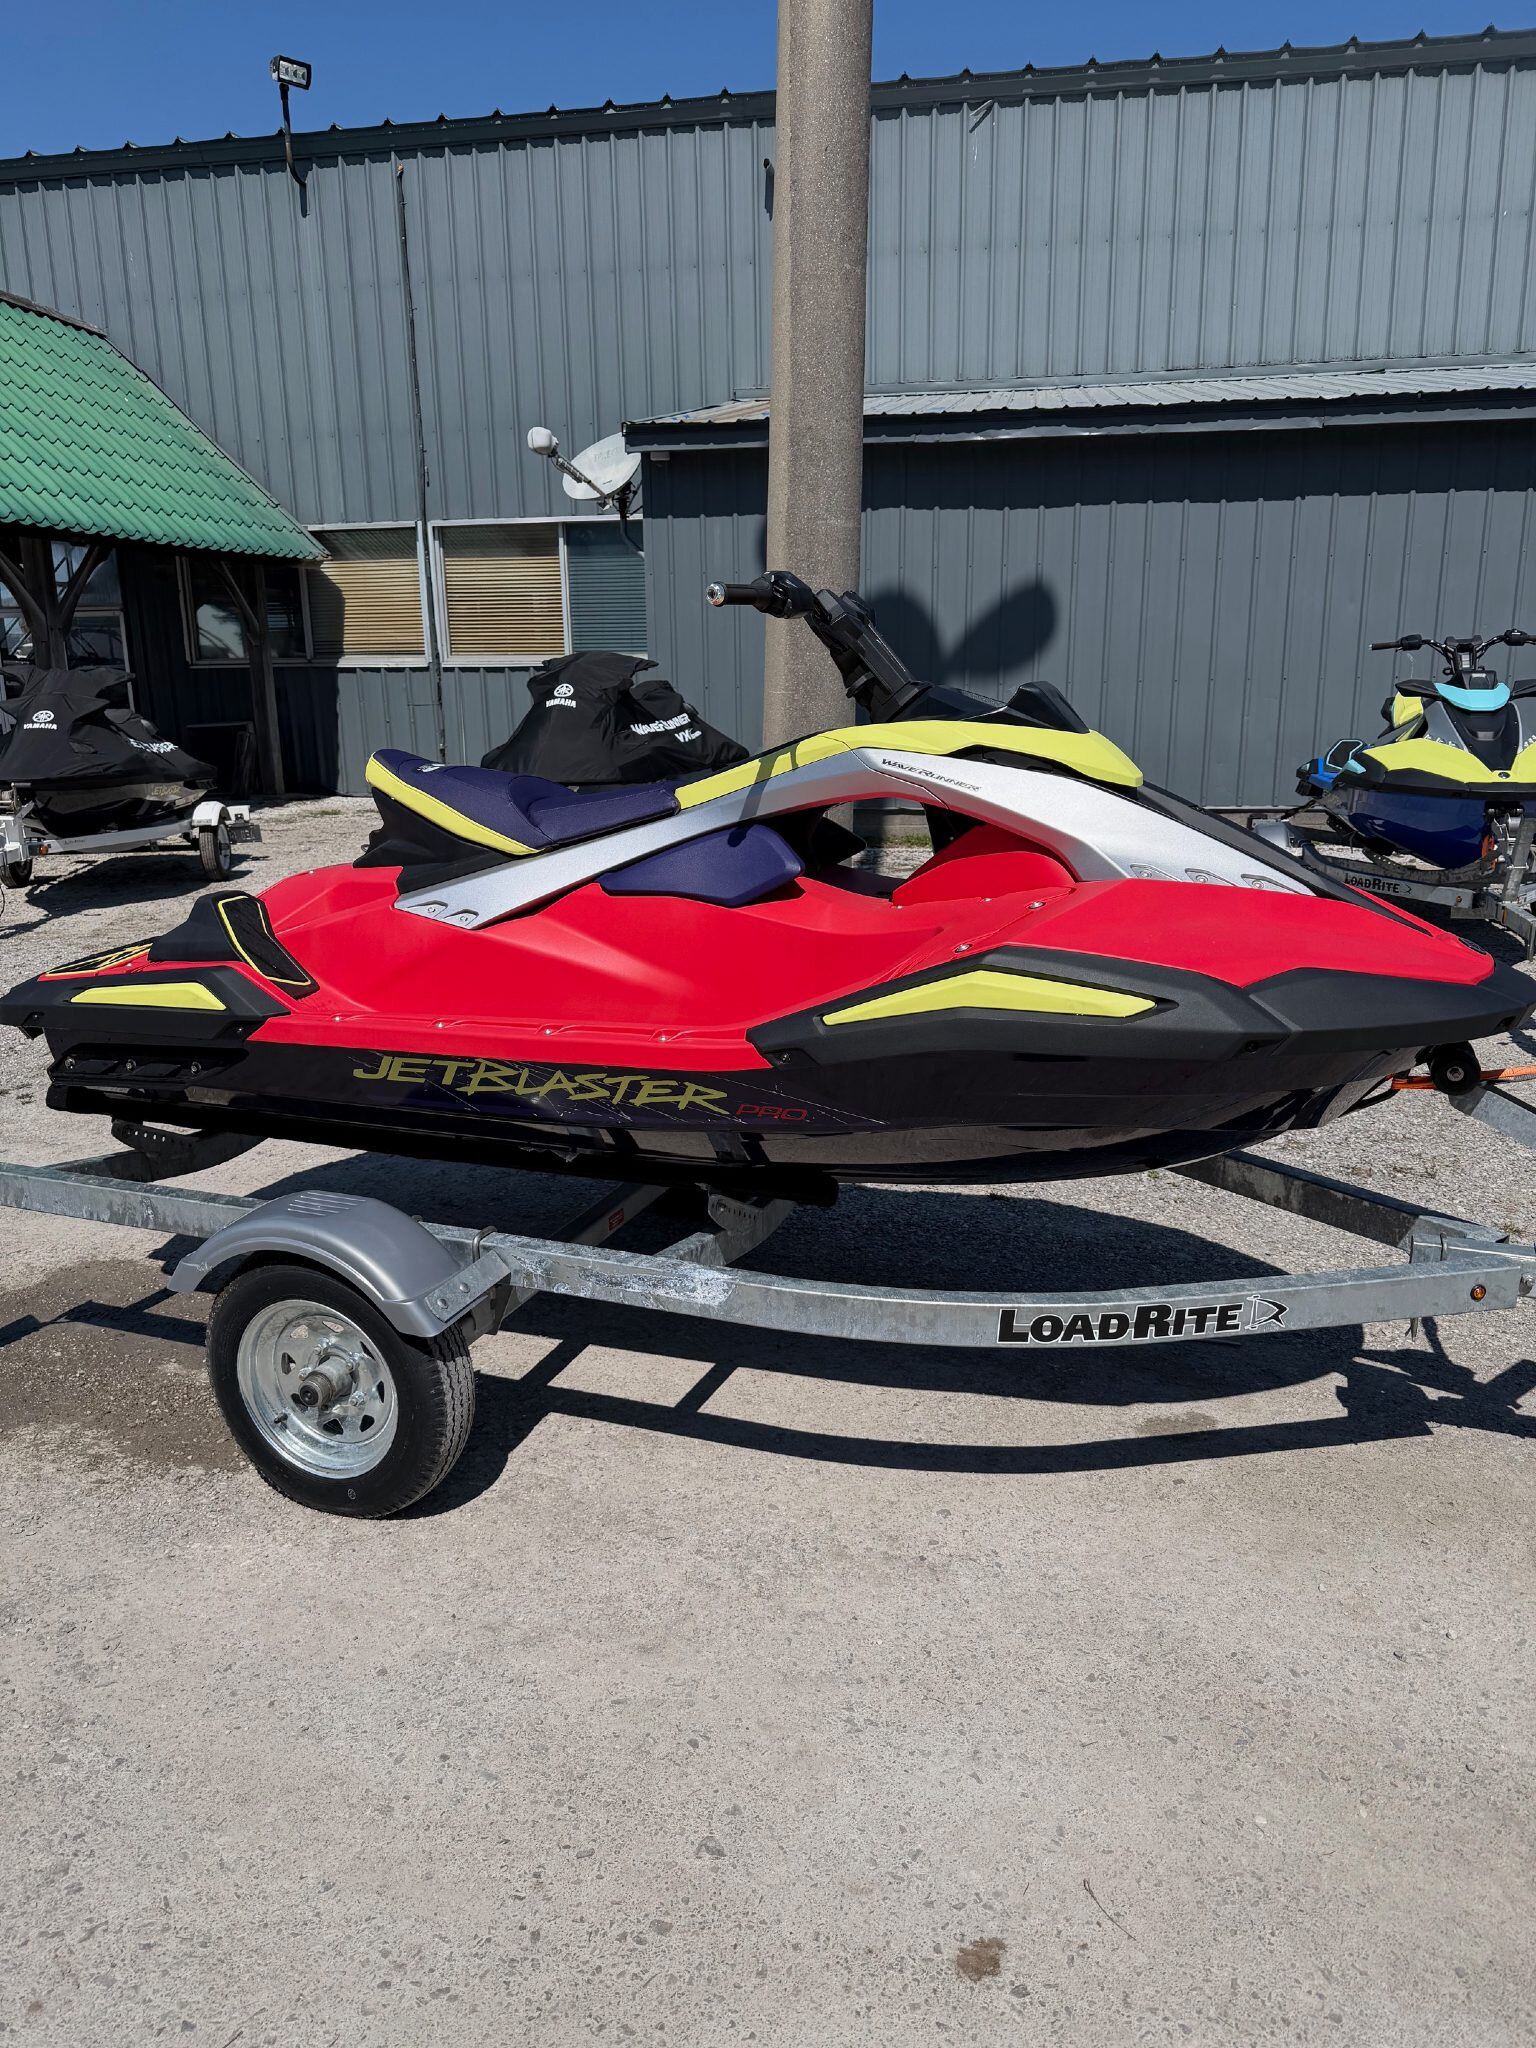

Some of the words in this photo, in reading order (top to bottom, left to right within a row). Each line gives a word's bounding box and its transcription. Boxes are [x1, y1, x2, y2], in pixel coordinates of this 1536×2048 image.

[545, 698, 577, 708] YAMAHA
[23, 722, 57, 730] YAMAHA
[674, 729, 692, 742] VX
[882, 758, 982, 791] WAVERUNNER
[1344, 873, 1400, 893] LOADRITE
[353, 1056, 730, 1114] JETBLASTER
[736, 1103, 809, 1121] PRO
[997, 1302, 1244, 1343] LOADRITE
